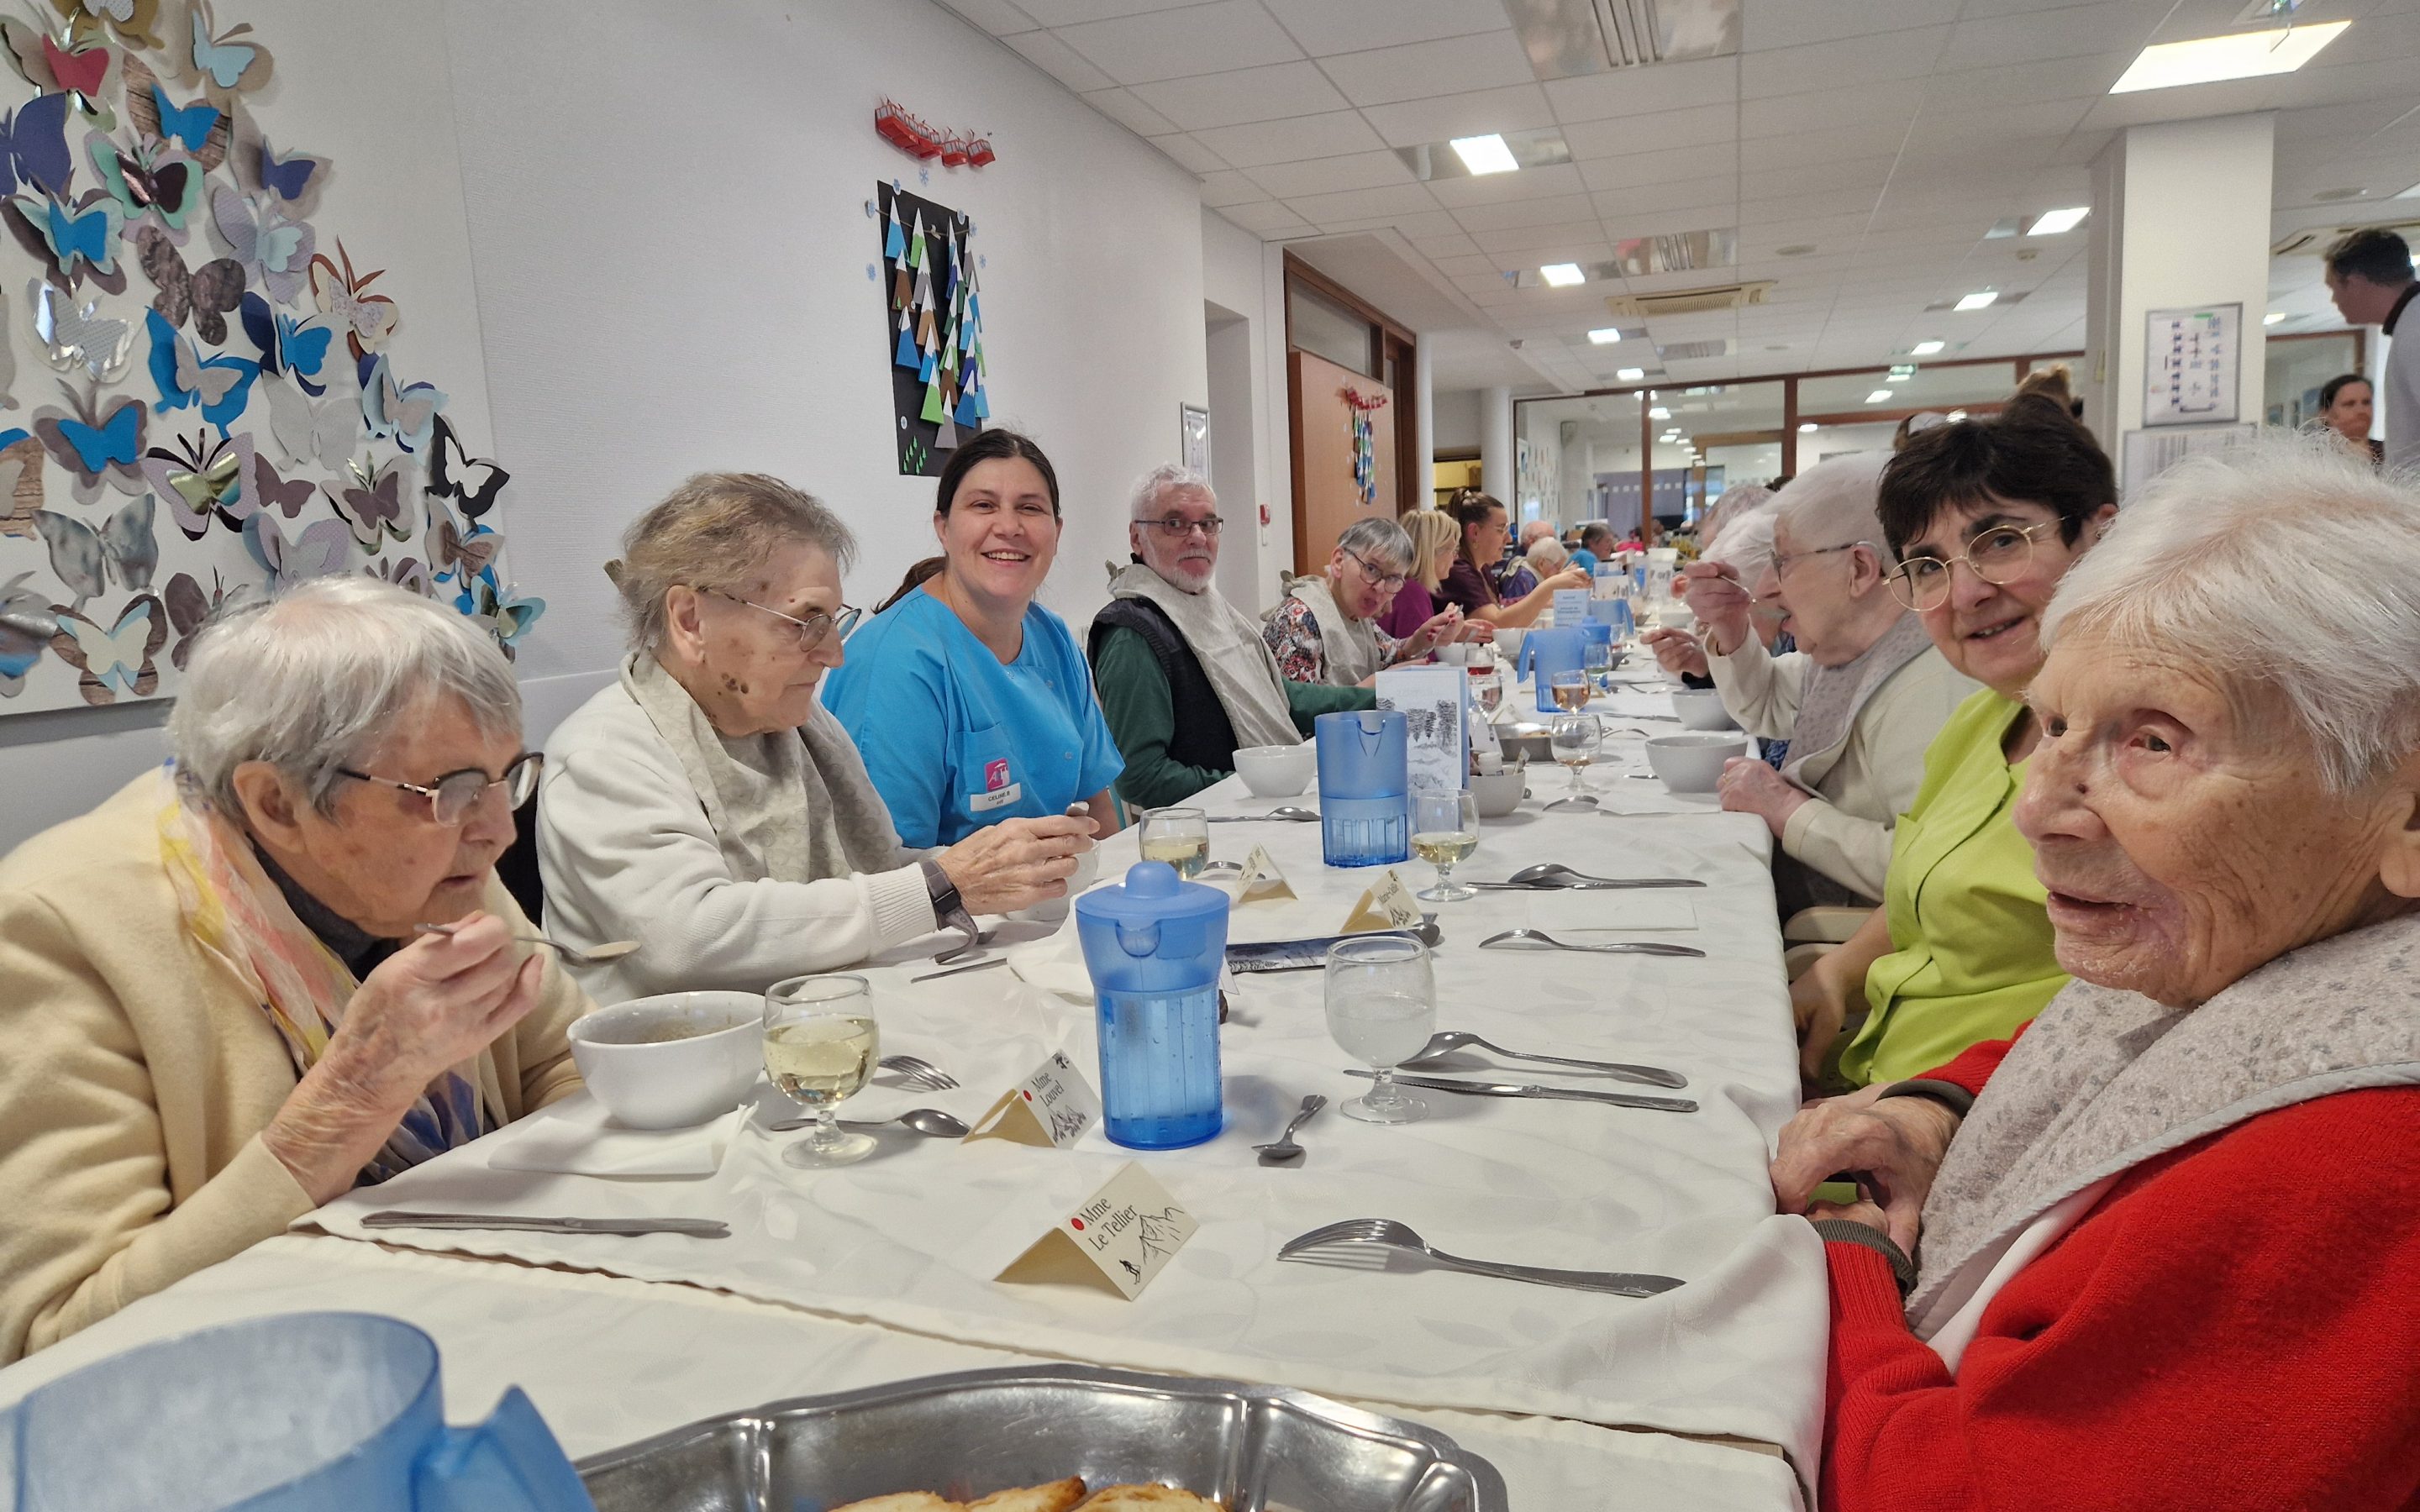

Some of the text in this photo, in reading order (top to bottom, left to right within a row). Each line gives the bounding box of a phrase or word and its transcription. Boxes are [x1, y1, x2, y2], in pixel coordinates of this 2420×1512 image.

[987, 792, 1007, 802] CELINE
[1031, 1072, 1052, 1092] Mme
[1039, 1079, 1065, 1107] Louvel
[1079, 1198, 1112, 1226] Mme
[1088, 1205, 1138, 1251] Le Tellier
